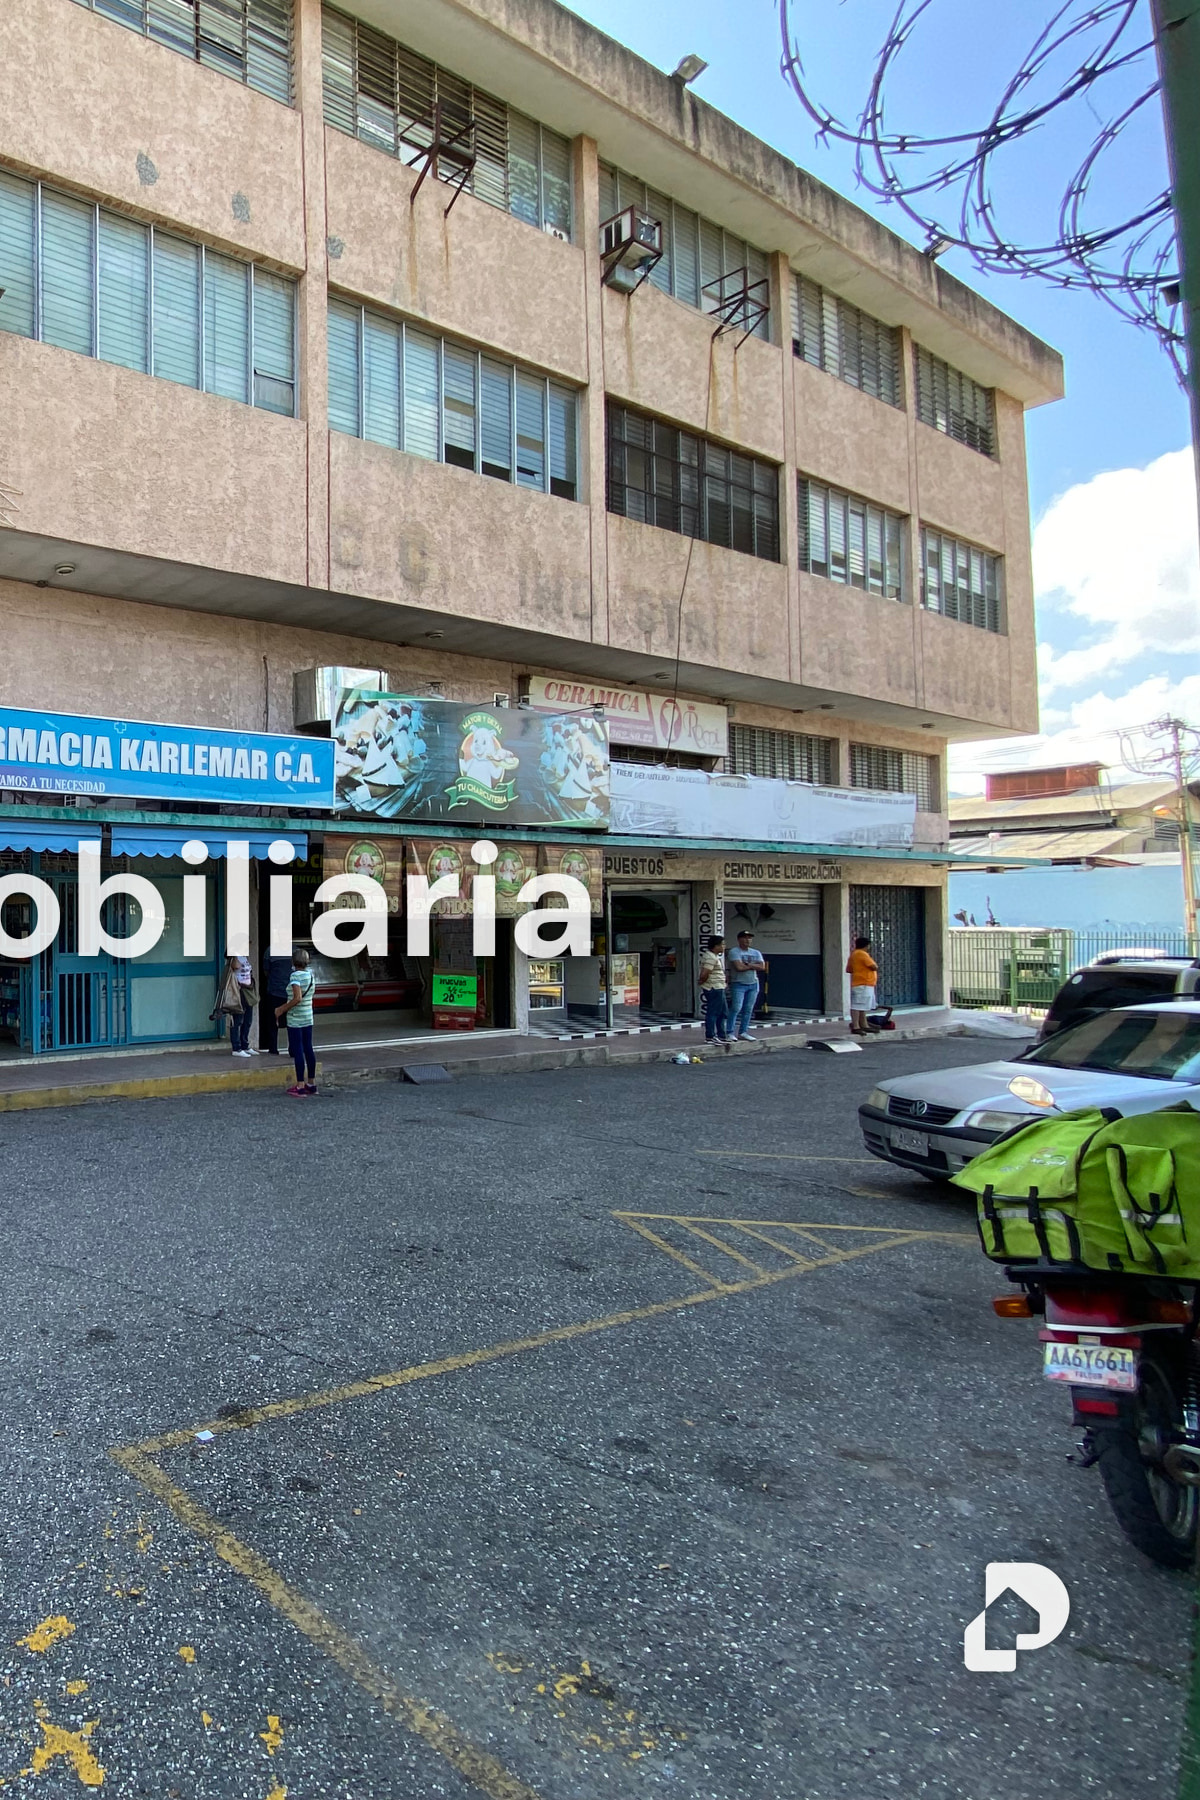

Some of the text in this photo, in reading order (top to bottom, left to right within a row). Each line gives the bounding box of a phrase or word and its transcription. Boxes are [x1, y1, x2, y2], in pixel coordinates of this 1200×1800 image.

[543, 681, 640, 713] CERAMICA
[120, 737, 268, 781] KARLEMAR
[274, 751, 321, 784] C.A.
[30, 778, 37, 788] A
[40, 777, 52, 789] TU
[54, 778, 106, 793] NECESIDAD
[457, 783, 467, 791] TU
[603, 856, 664, 876] PUESTOS
[724, 862, 764, 879] CENTRO
[767, 863, 781, 879] DE
